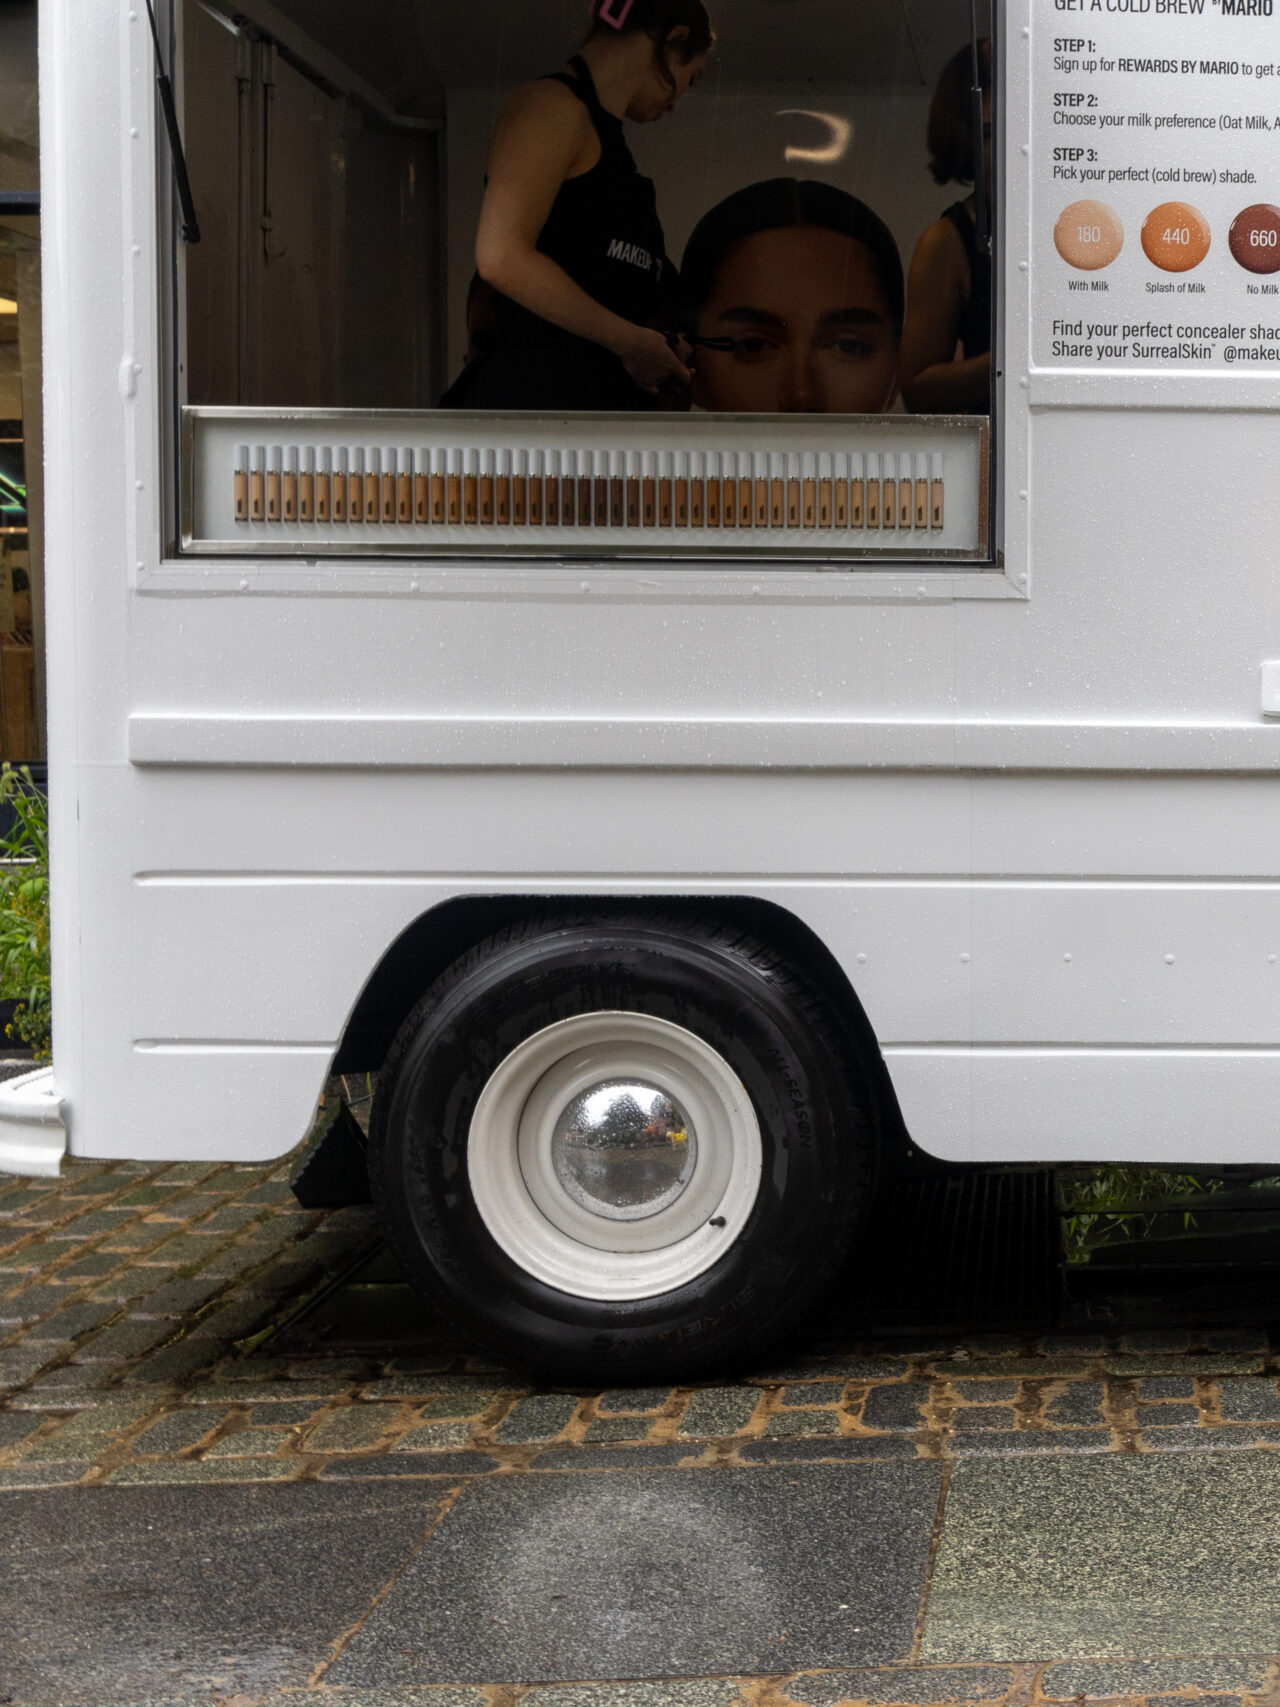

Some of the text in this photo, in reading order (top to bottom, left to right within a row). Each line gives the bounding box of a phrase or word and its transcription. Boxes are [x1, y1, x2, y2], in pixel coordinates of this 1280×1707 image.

[1055, 0, 1083, 11] GET
[1090, 0, 1102, 11] A
[1106, 0, 1150, 13] COLD
[1156, 0, 1205, 14] BREW
[1222, 0, 1273, 16] MARIO
[1054, 38, 1095, 52] STEP 1:
[1054, 56, 1079, 73] Sign
[1082, 61, 1097, 74] up
[1100, 57, 1115, 71] for
[1119, 58, 1178, 73] REWARDS
[1181, 60, 1197, 73] BY
[1200, 61, 1239, 75] MARIO
[1241, 62, 1253, 75] to
[1256, 64, 1274, 79] get
[1054, 93, 1098, 107] STEP 2:
[1054, 111, 1096, 125] Choose
[1099, 116, 1125, 129] your
[1128, 113, 1152, 126] milk
[1155, 114, 1216, 130] preference
[1219, 115, 1242, 131] (Oat
[1246, 116, 1271, 131] Milk,
[1053, 147, 1097, 161] STEP 3:
[1054, 166, 1256, 184] Pick your perfect (cold brew) shade.
[1076, 226, 1101, 243] 180
[1161, 227, 1190, 245] 440
[1249, 229, 1277, 247] 660
[1069, 281, 1108, 291] With Milk
[1146, 282, 1205, 294] Splash of Milk
[1247, 285, 1278, 294] No Milk
[1053, 320, 1082, 336] Find
[1087, 325, 1118, 340] your
[1123, 322, 1173, 340] perfect
[1177, 324, 1246, 341] concealer
[1052, 339, 1092, 356] Share
[1097, 345, 1128, 360] your
